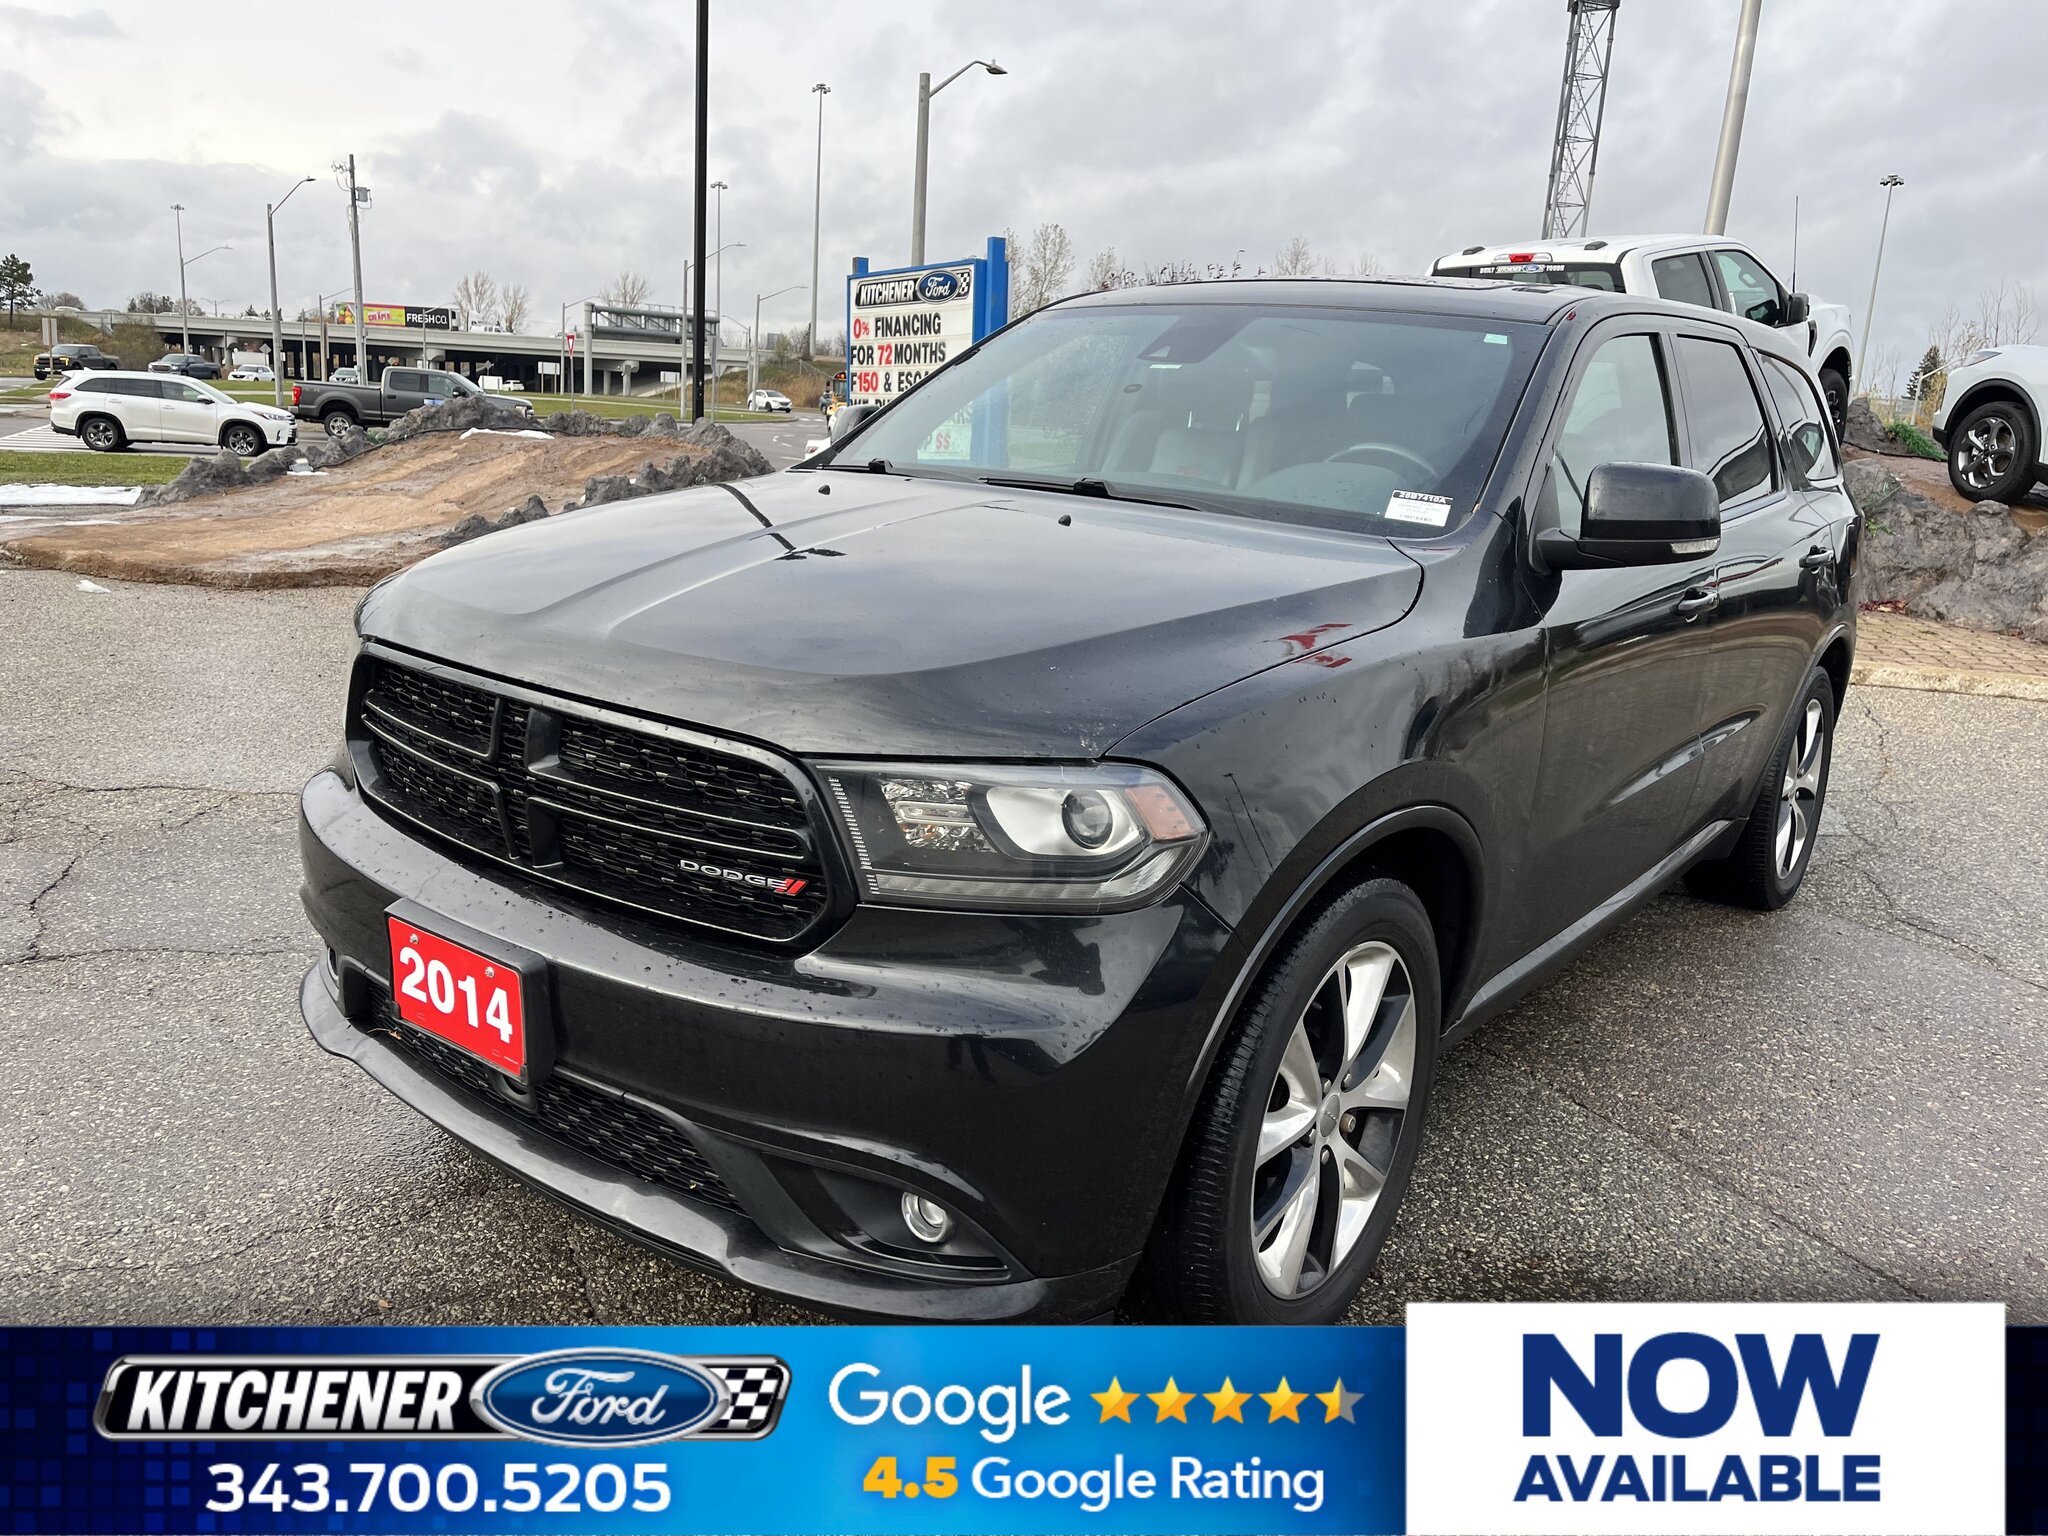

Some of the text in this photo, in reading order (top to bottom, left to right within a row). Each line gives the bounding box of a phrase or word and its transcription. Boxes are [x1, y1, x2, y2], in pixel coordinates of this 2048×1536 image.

[859, 276, 951, 306] KITCHENER Ford
[853, 312, 942, 339] 0% FINANCING
[850, 341, 946, 366] FOR 72 MONTHS
[850, 371, 879, 393] F150
[883, 372, 892, 393] &
[679, 859, 788, 890] DODGE
[399, 946, 513, 1044] 2014
